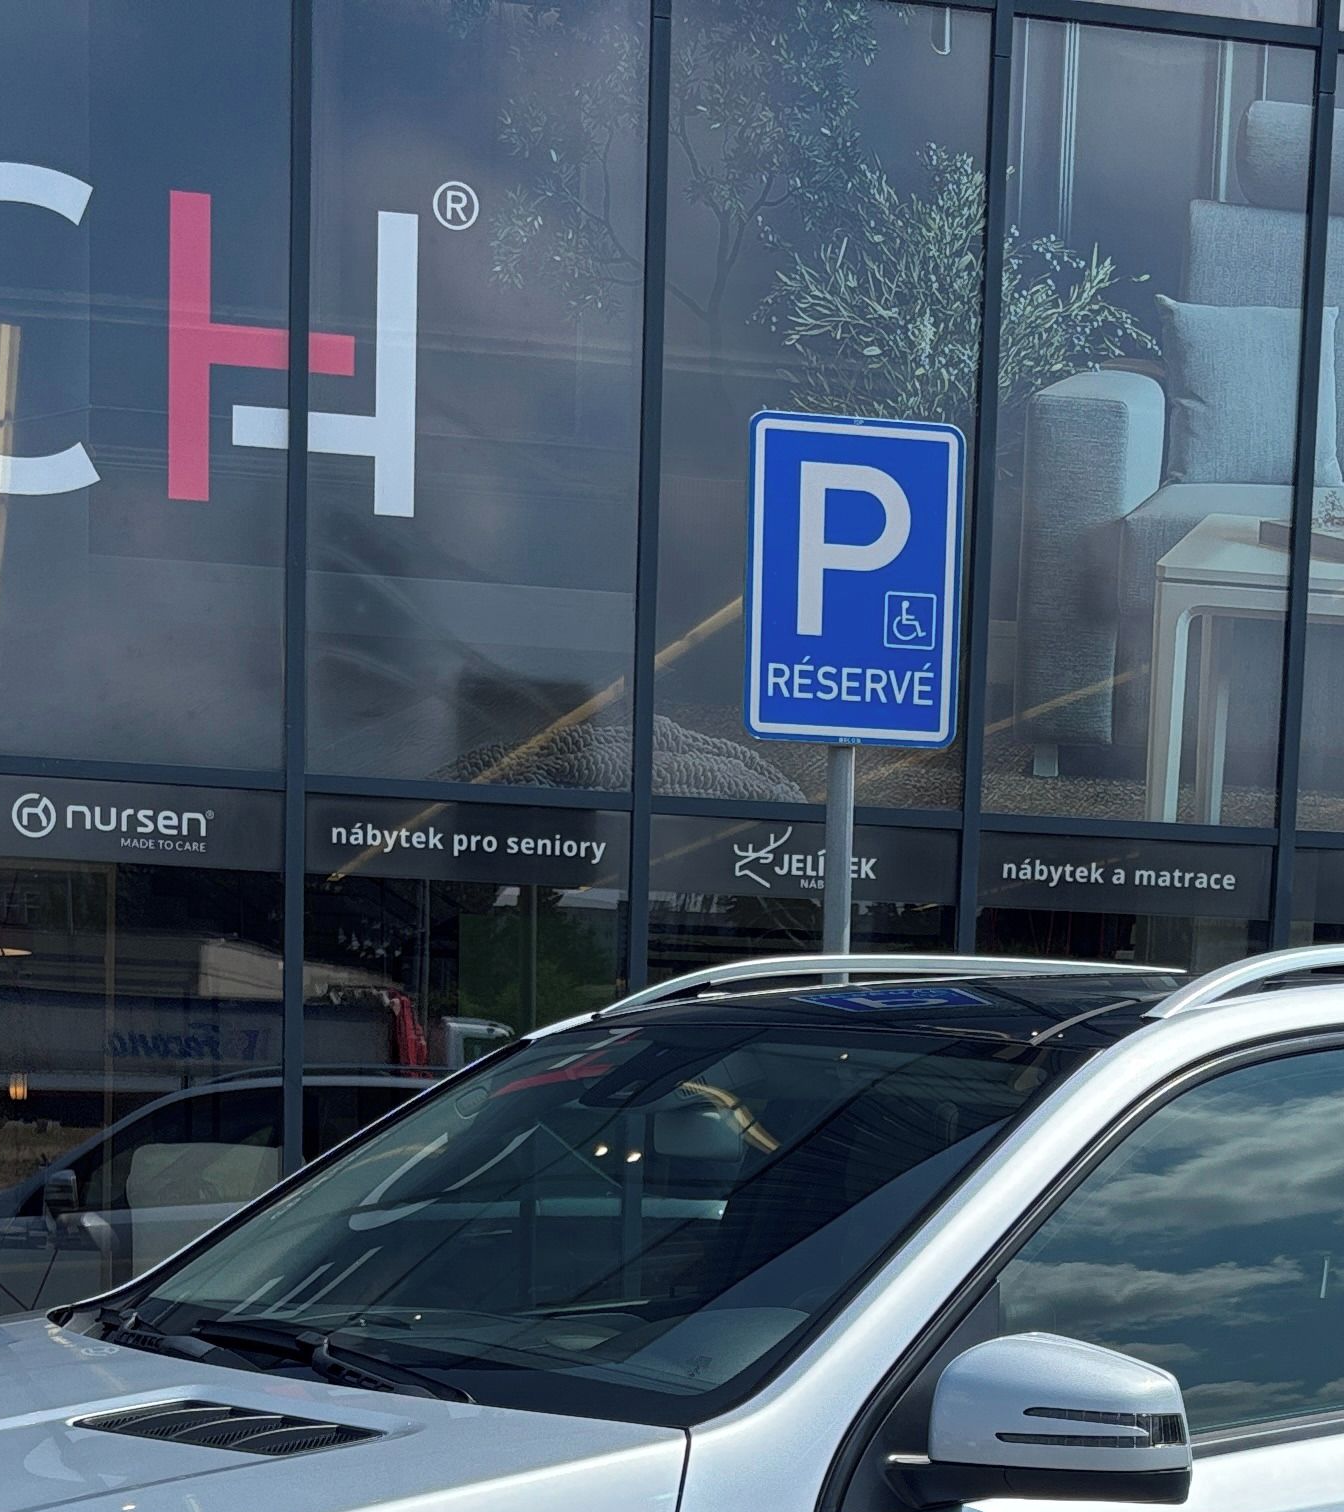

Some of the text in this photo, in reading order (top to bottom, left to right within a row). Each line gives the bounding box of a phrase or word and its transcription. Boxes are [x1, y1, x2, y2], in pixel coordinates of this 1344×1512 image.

[795, 460, 912, 637] P
[767, 656, 936, 707] RÉSERVÉ
[120, 837, 208, 853] MADE TO CARE
[331, 820, 609, 865] nábytek pro seniory
[774, 849, 877, 880] JELÍEK
[1002, 858, 1236, 890] nábytek a matrace
